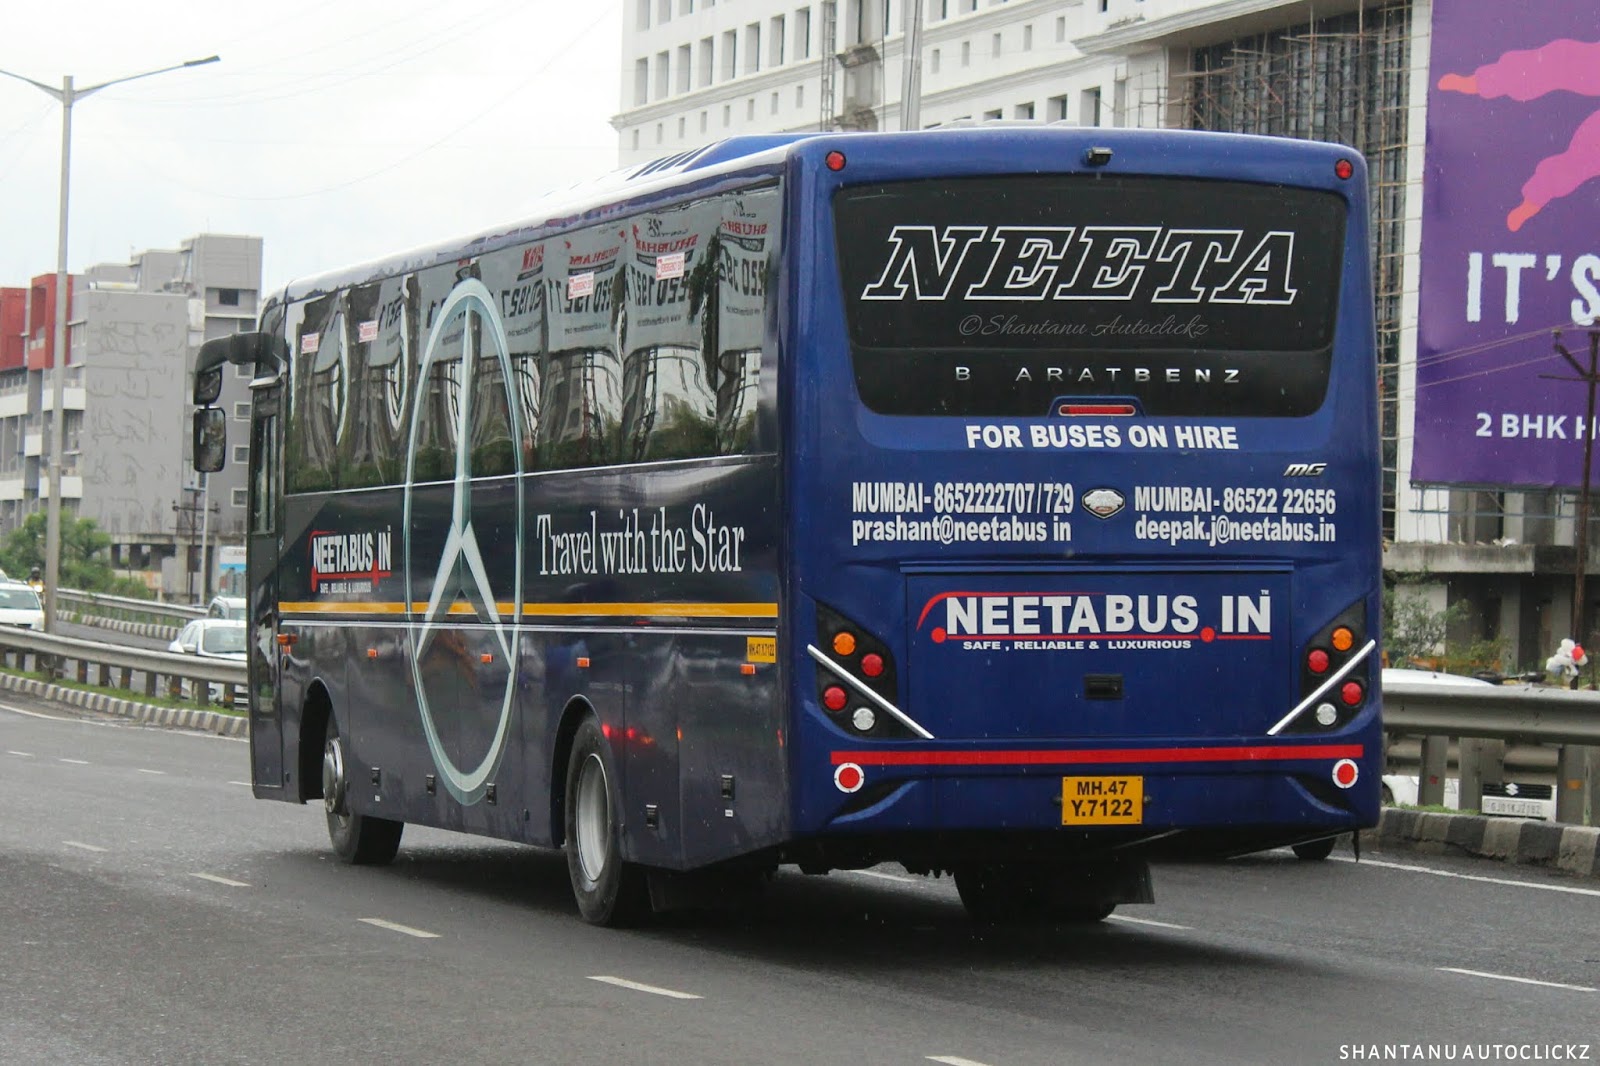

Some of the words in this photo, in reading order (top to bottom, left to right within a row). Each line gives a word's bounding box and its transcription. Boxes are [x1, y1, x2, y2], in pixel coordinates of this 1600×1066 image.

[861, 225, 1298, 305] NEETA
[965, 424, 1023, 449] FOR
[1030, 424, 1121, 448] BUSES
[1129, 425, 1168, 448] ON
[1175, 425, 1239, 449] HIRE
[1475, 412, 1493, 437] 2
[1501, 413, 1567, 440] BHK
[1223, 487, 1278, 513] 86522
[1282, 488, 1336, 514] 22656
[536, 511, 598, 576] Travel
[600, 508, 647, 575] with
[650, 507, 686, 573] the
[691, 502, 745, 573] Star
[852, 515, 1048, 546] prashant@neetabus
[1053, 515, 1072, 542] in
[1135, 514, 1336, 547] deepak.j@neetabus.in
[1013, 641, 1085, 650] RELIABLE
[1088, 641, 1100, 650] &
[1108, 640, 1192, 650] LUXURIOUS
[1077, 781, 1128, 796] MH.47
[1071, 798, 1133, 817] Y.7122
